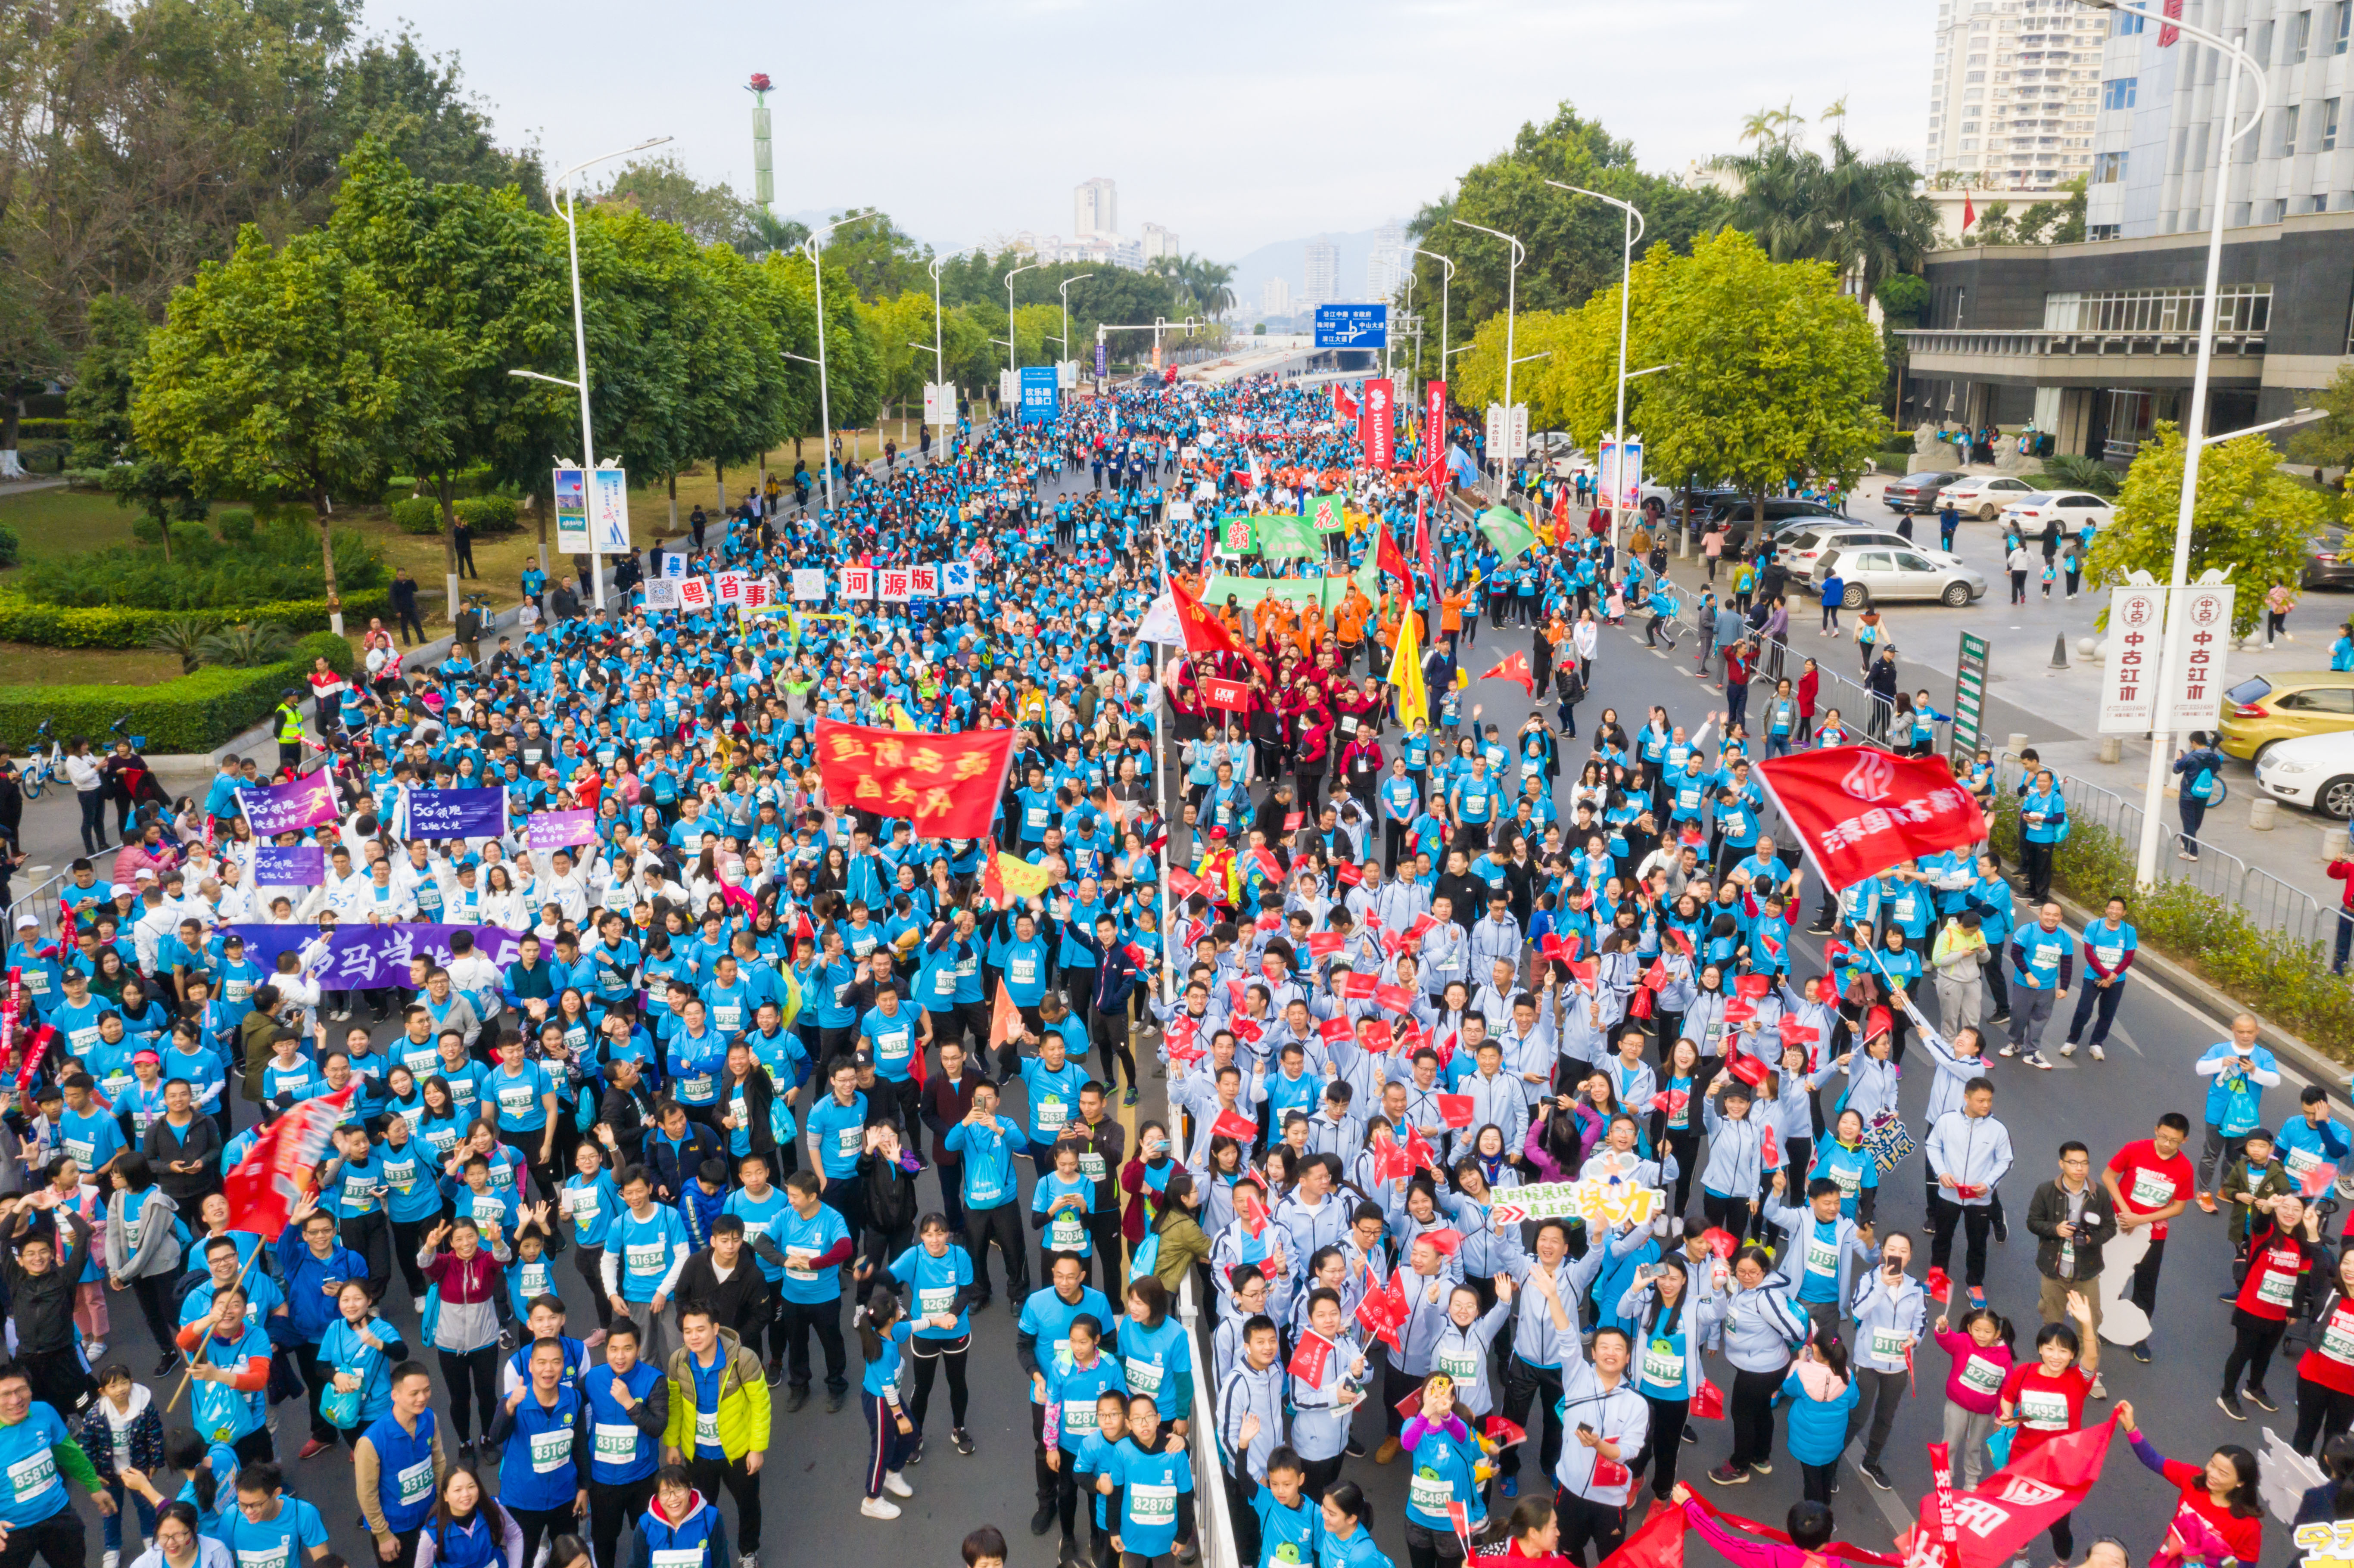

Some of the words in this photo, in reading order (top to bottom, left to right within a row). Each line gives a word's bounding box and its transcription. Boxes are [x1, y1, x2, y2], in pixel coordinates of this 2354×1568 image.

[1025, 388, 1051, 396] 欢乐跑
[1026, 397, 1052, 405] 检录口
[1373, 414, 1384, 462] HUAWEI
[1314, 500, 1339, 530] 花
[1227, 520, 1250, 550] 霸
[719, 575, 739, 599] 省
[846, 572, 868, 595] 河
[885, 574, 907, 597] 源
[912, 569, 934, 591] 版
[682, 581, 705, 605] 粤
[745, 585, 766, 608] 事
[1215, 688, 1235, 698] LKM
[715, 1014, 739, 1023] 87329
[563, 1035, 586, 1046] 1329
[451, 1088, 472, 1096] 1335
[685, 1082, 711, 1093] 87059
[1040, 1112, 1065, 1122] 82638
[434, 1138, 455, 1150] 1332
[1080, 1161, 1103, 1172] 1982
[489, 1173, 511, 1184] 1341
[1493, 1185, 1572, 1204] 是时候展现
[2136, 1182, 2170, 1201] 84772
[574, 1198, 596, 1208] 1328
[1529, 1202, 1576, 1218] 真正的
[1054, 1230, 1084, 1241] 82036
[629, 1253, 663, 1265] 81634
[1441, 1359, 1474, 1372] 81118
[1645, 1360, 1681, 1378] 81112
[1127, 1369, 1160, 1388] 82879
[2024, 1402, 2066, 1418] 84954
[1068, 1413, 1096, 1424] 8287
[534, 1441, 570, 1460] 83160
[597, 1437, 634, 1450] 83159
[14, 1459, 55, 1488] 85810
[1413, 1489, 1451, 1504] 86480
[1133, 1498, 1173, 1511] 82878
[1934, 1469, 1957, 1542] 农夫山泉
